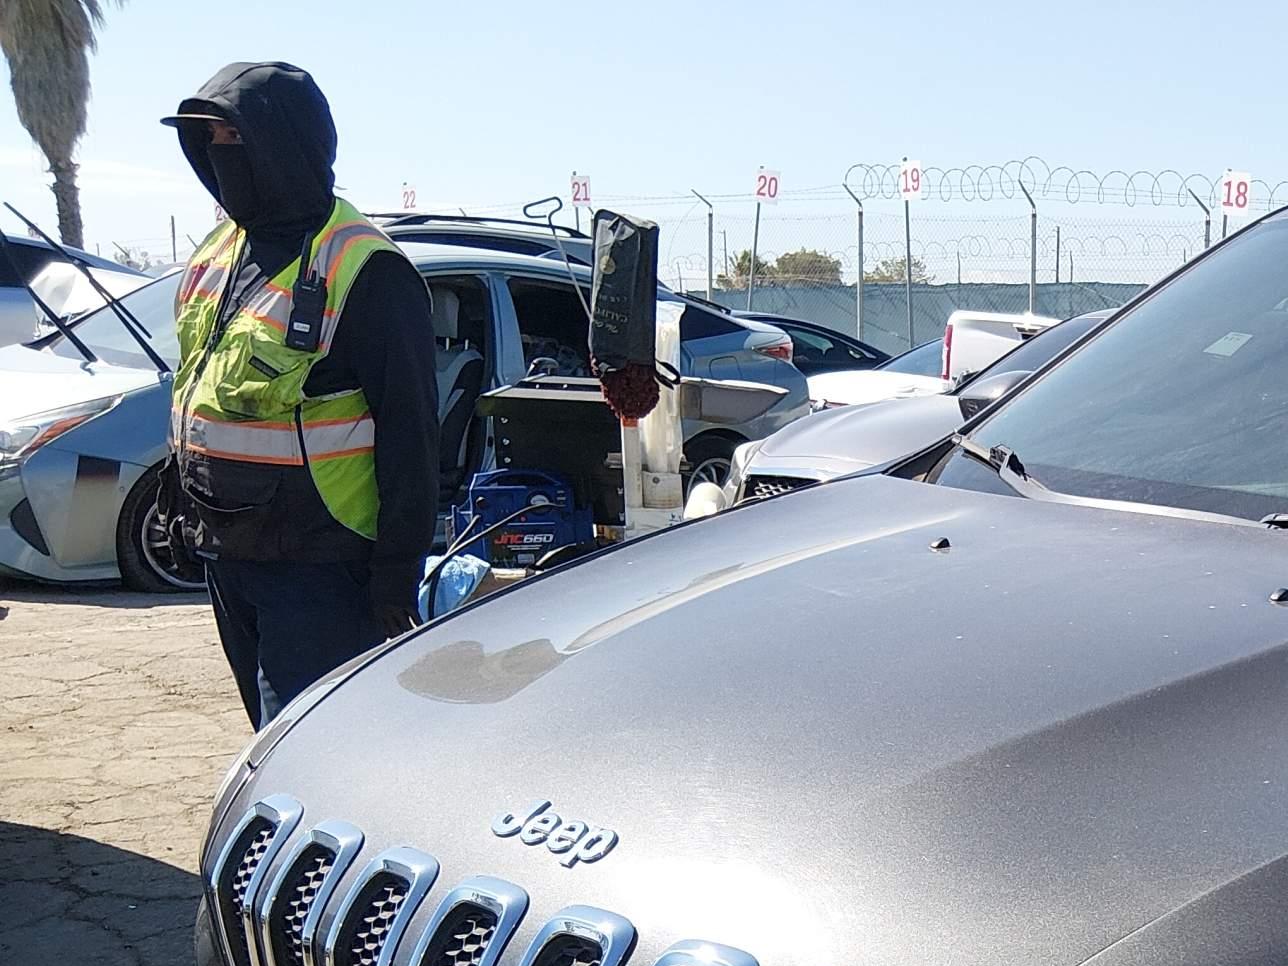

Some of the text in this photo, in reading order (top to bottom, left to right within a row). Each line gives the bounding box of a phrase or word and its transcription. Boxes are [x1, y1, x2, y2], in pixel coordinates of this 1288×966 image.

[572, 182, 590, 201] 21
[755, 175, 779, 198] 20
[902, 168, 920, 193] 19
[403, 189, 417, 209] 22
[1222, 180, 1248, 209] 18
[494, 533, 555, 545] JNC660
[490, 799, 620, 869] Jeep
